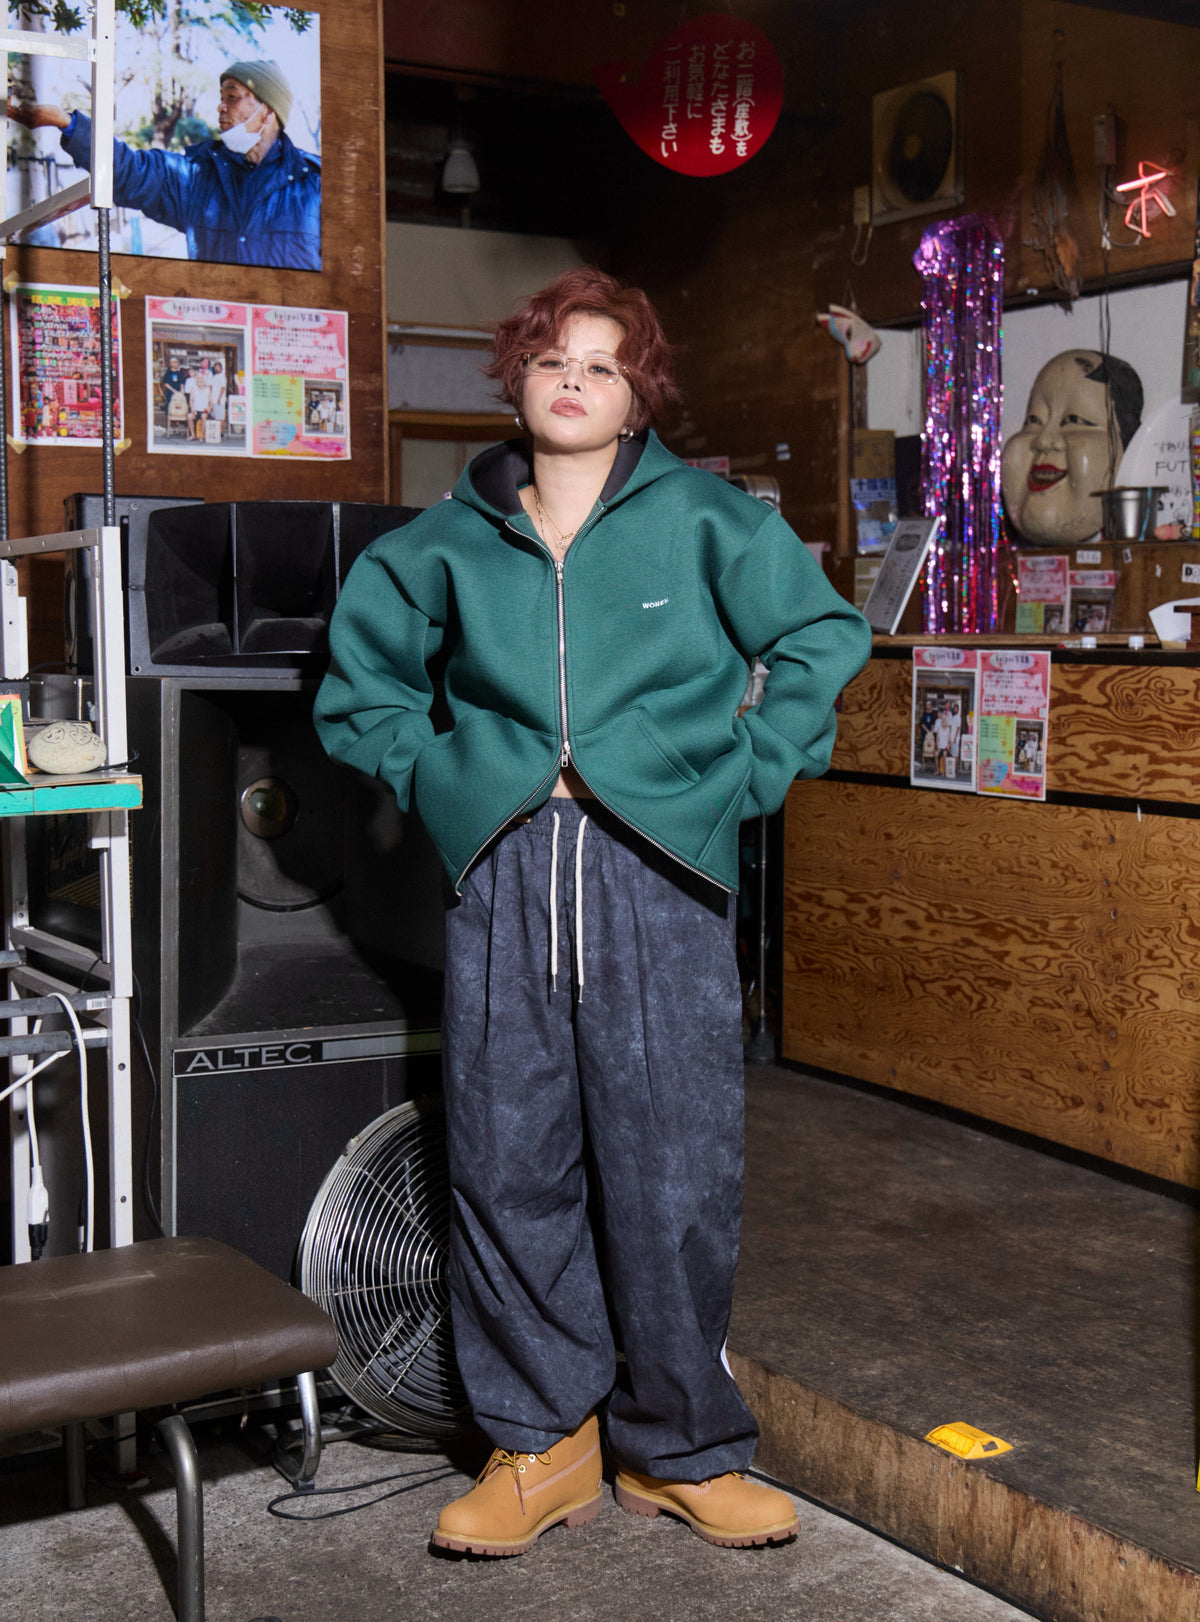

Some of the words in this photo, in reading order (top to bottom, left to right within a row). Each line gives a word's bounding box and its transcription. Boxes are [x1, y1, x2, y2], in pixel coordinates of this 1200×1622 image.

[661, 43, 682, 158] ご利用下さい
[686, 44, 706, 120] お気軽に
[709, 40, 733, 155] どなたさまも
[185, 1043, 312, 1072] ALTEC
